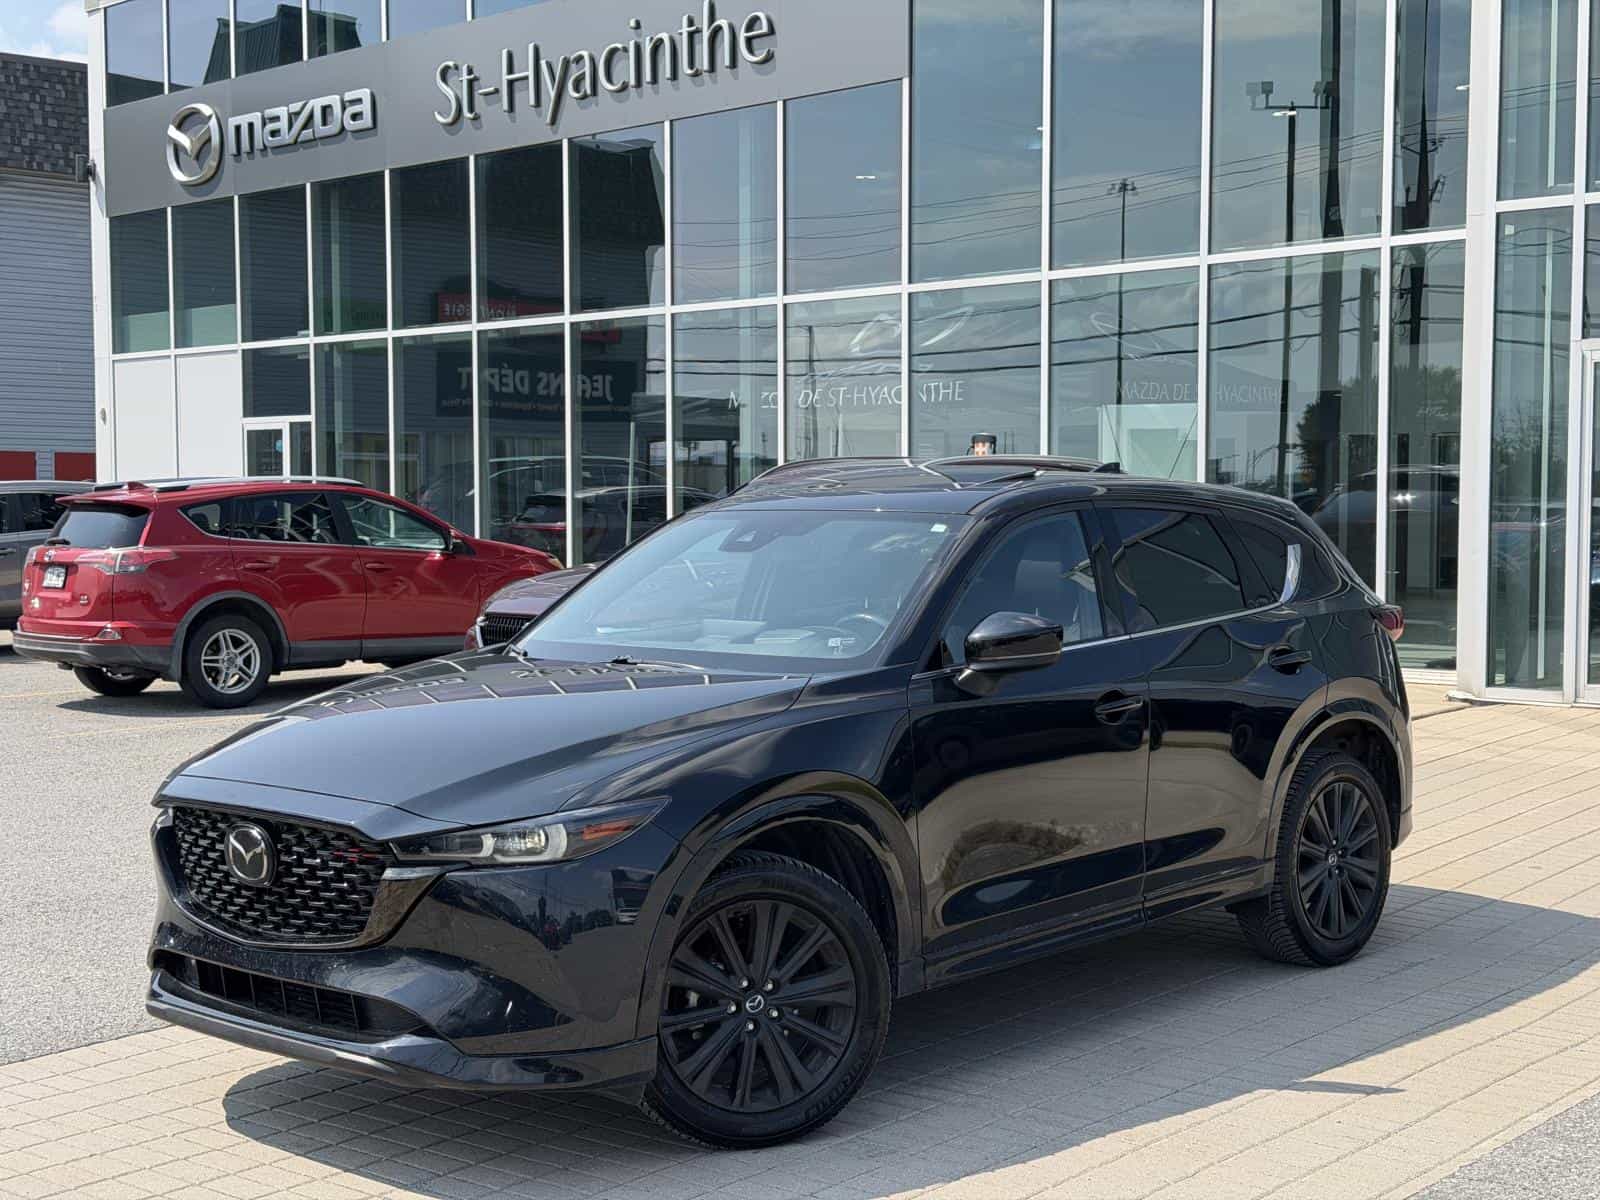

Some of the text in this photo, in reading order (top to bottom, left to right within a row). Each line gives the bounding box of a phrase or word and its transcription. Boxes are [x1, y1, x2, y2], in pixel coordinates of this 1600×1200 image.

[434, 0, 775, 125] St-Hyacinthe
[799, 388, 823, 407] DE
[826, 381, 963, 406] ST-HYACNTHE
